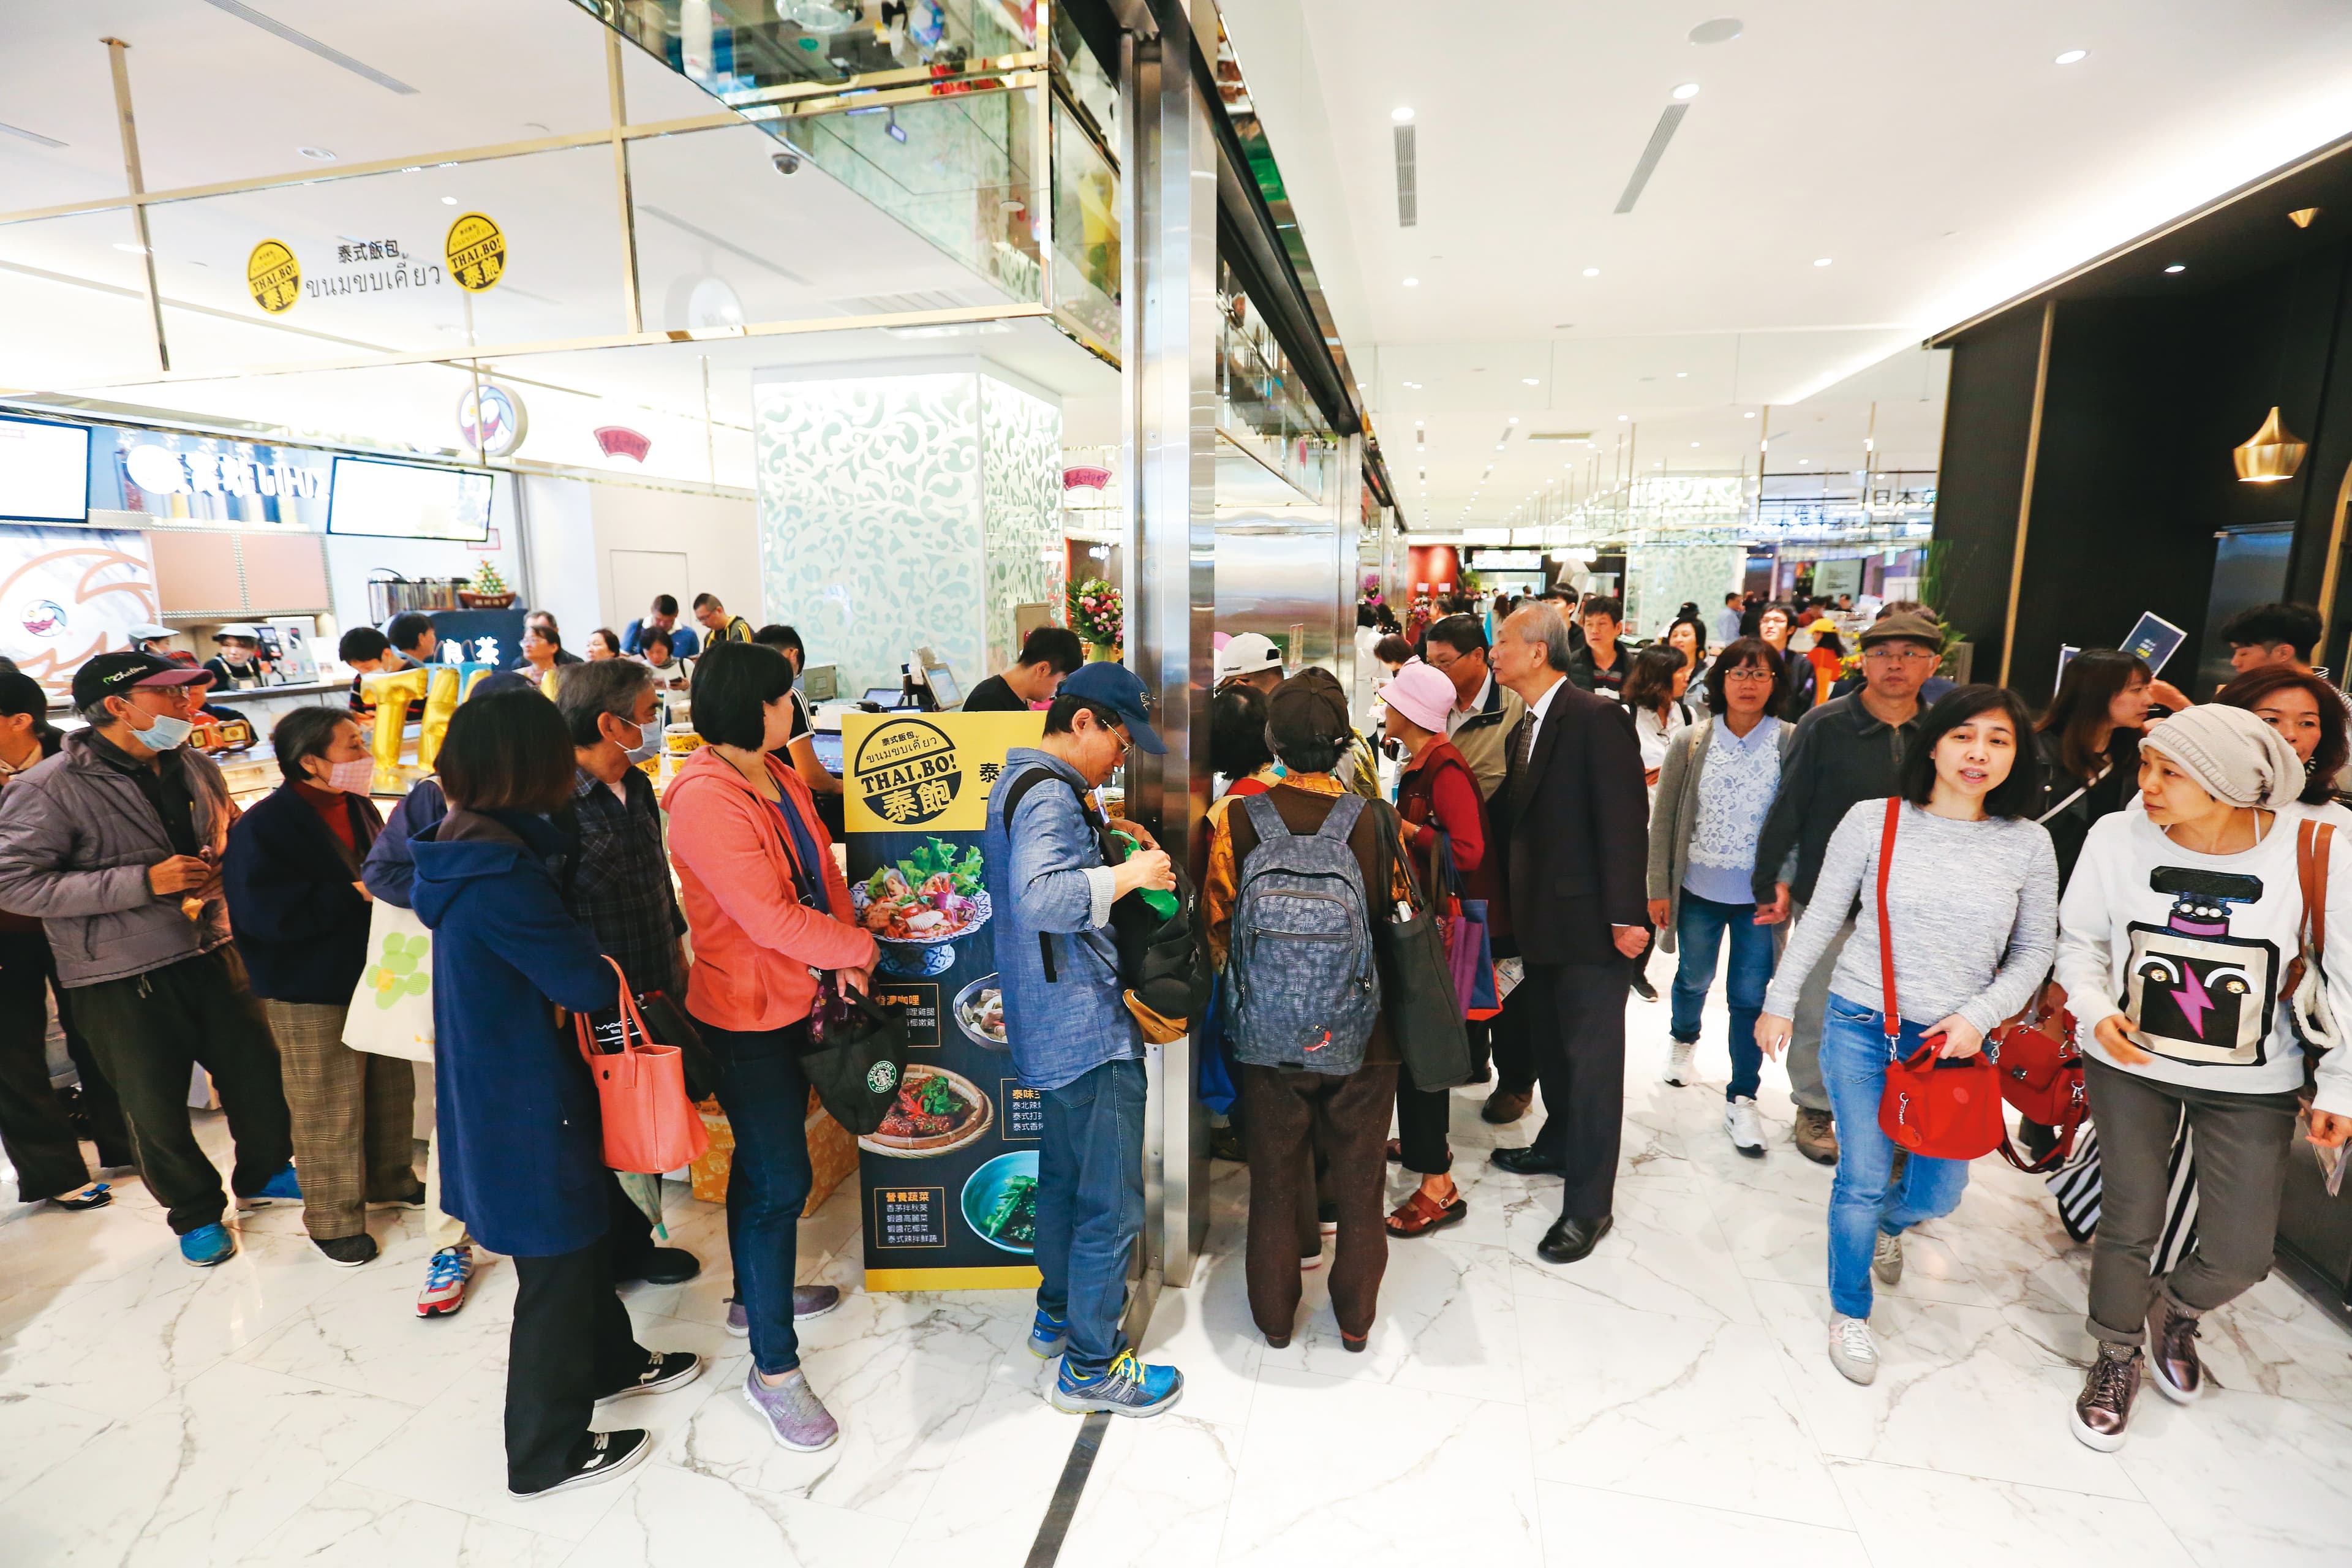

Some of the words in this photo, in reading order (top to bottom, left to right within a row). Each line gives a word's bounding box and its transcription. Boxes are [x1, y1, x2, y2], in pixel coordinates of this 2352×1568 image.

[338, 239, 399, 263] 泰式飯包
[451, 238, 502, 269] THAI.BO!
[882, 731, 914, 746] 泰式飯包
[861, 753, 957, 794] THAI.BO!
[980, 763, 1005, 783] 泰
[881, 780, 951, 821] 泰飽
[869, 1063, 893, 1082] STARBUCKS
[875, 1079, 894, 1091] COFFEE
